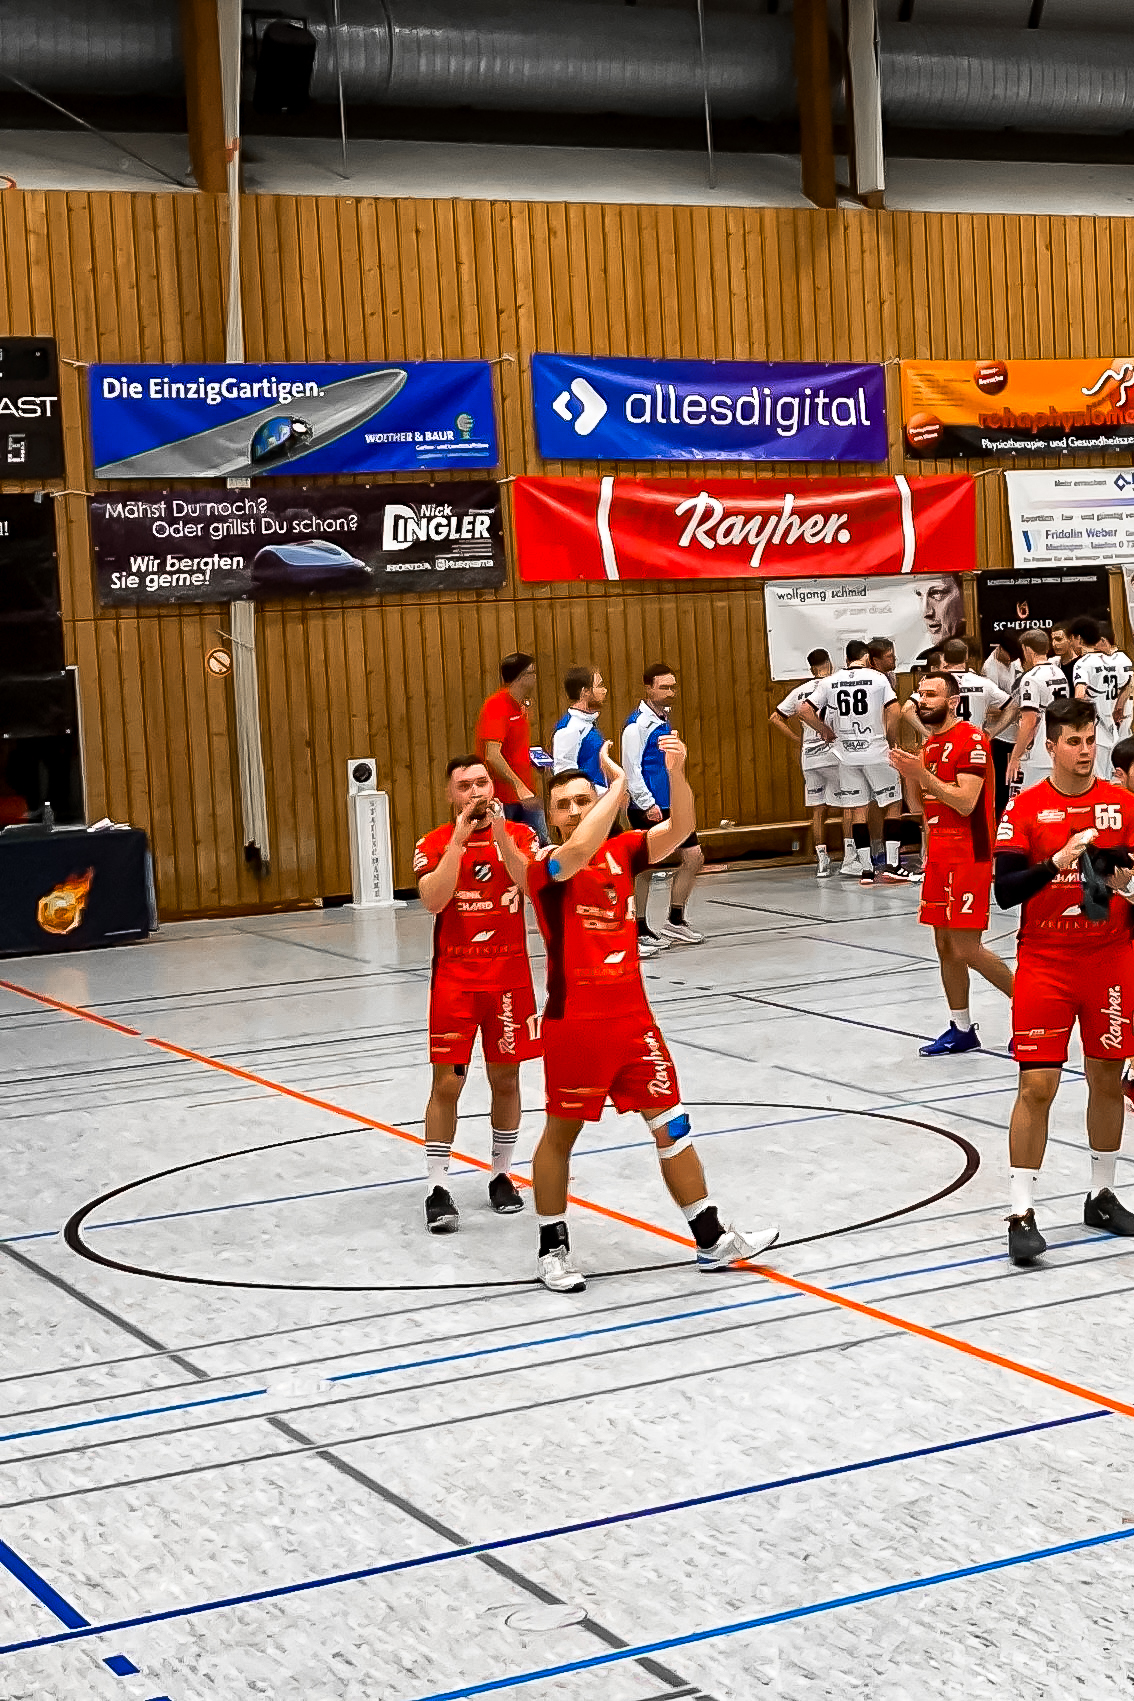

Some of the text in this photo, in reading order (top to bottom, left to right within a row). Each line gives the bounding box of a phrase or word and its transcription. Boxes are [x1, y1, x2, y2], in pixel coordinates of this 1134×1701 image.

[102, 376, 325, 404] Die EinzigGartigen.
[625, 384, 871, 437] allesdigital
[414, 431, 424, 441] &
[1049, 437, 1067, 448] und
[105, 497, 268, 520] Mähst Du noch?
[420, 503, 453, 517] Nick
[152, 514, 359, 540] Oder grillst Du schon?
[382, 504, 492, 551] DINGLER
[674, 490, 852, 569] Rayher.
[1045, 529, 1083, 540] Fridolin
[1085, 527, 1118, 539] Weber
[130, 554, 244, 573] Wir beraten
[110, 570, 212, 592] Sie gerne!
[776, 587, 827, 603] wolfgang
[836, 688, 869, 717] 68
[960, 892, 974, 914] 2
[1099, 985, 1131, 1050] Rayher.
